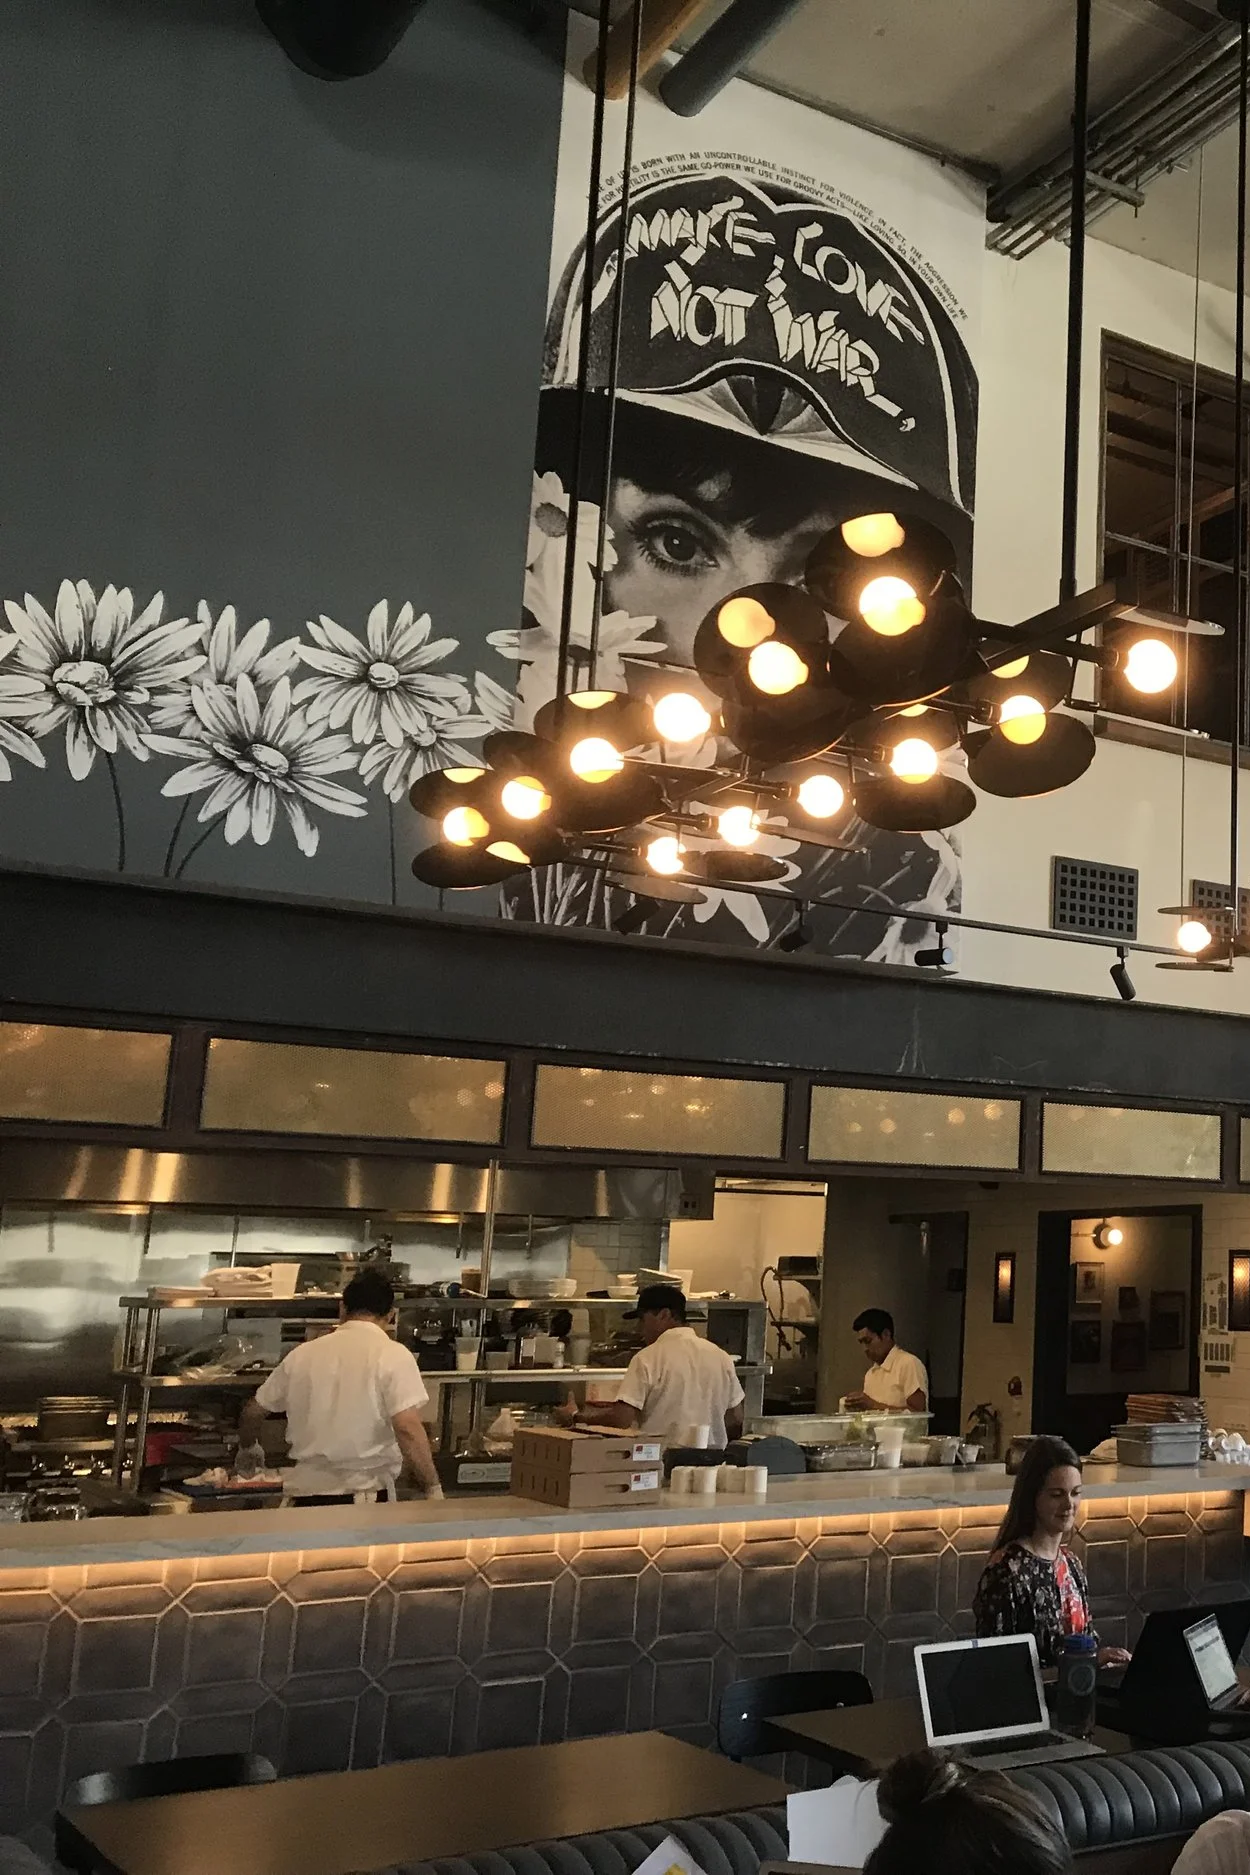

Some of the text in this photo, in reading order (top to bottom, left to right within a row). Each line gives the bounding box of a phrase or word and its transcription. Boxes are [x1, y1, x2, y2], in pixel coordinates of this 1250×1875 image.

[602, 190, 617, 204] FOR
[651, 170, 660, 178] IS
[661, 166, 676, 175] THE
[678, 163, 699, 173] SAME
[701, 162, 741, 171] GO-POWER
[744, 165, 756, 174] WE
[758, 168, 773, 180] USE
[776, 174, 791, 185] FOR
[793, 180, 824, 198] GROOVY
[909, 256, 917, 266] IN
[917, 264, 935, 285] YOUR
[933, 284, 947, 303] OWN
[605, 175, 616, 187] OF
[631, 165, 640, 174] IS
[640, 157, 663, 169] BORN
[665, 153, 686, 163] WITH
[690, 151, 700, 160] AN
[703, 151, 777, 171] UNCONTROLLABLE
[781, 166, 816, 185] INSTINCT
[820, 181, 835, 194] FOR
[877, 217, 887, 227] IN
[889, 226, 906, 246] FACT,
[910, 245, 922, 261] THE
[924, 261, 958, 306] AGGRESSION
[959, 307, 968, 320] WE
[625, 195, 925, 345] MAKE LOVE
[650, 260, 759, 346] NOT
